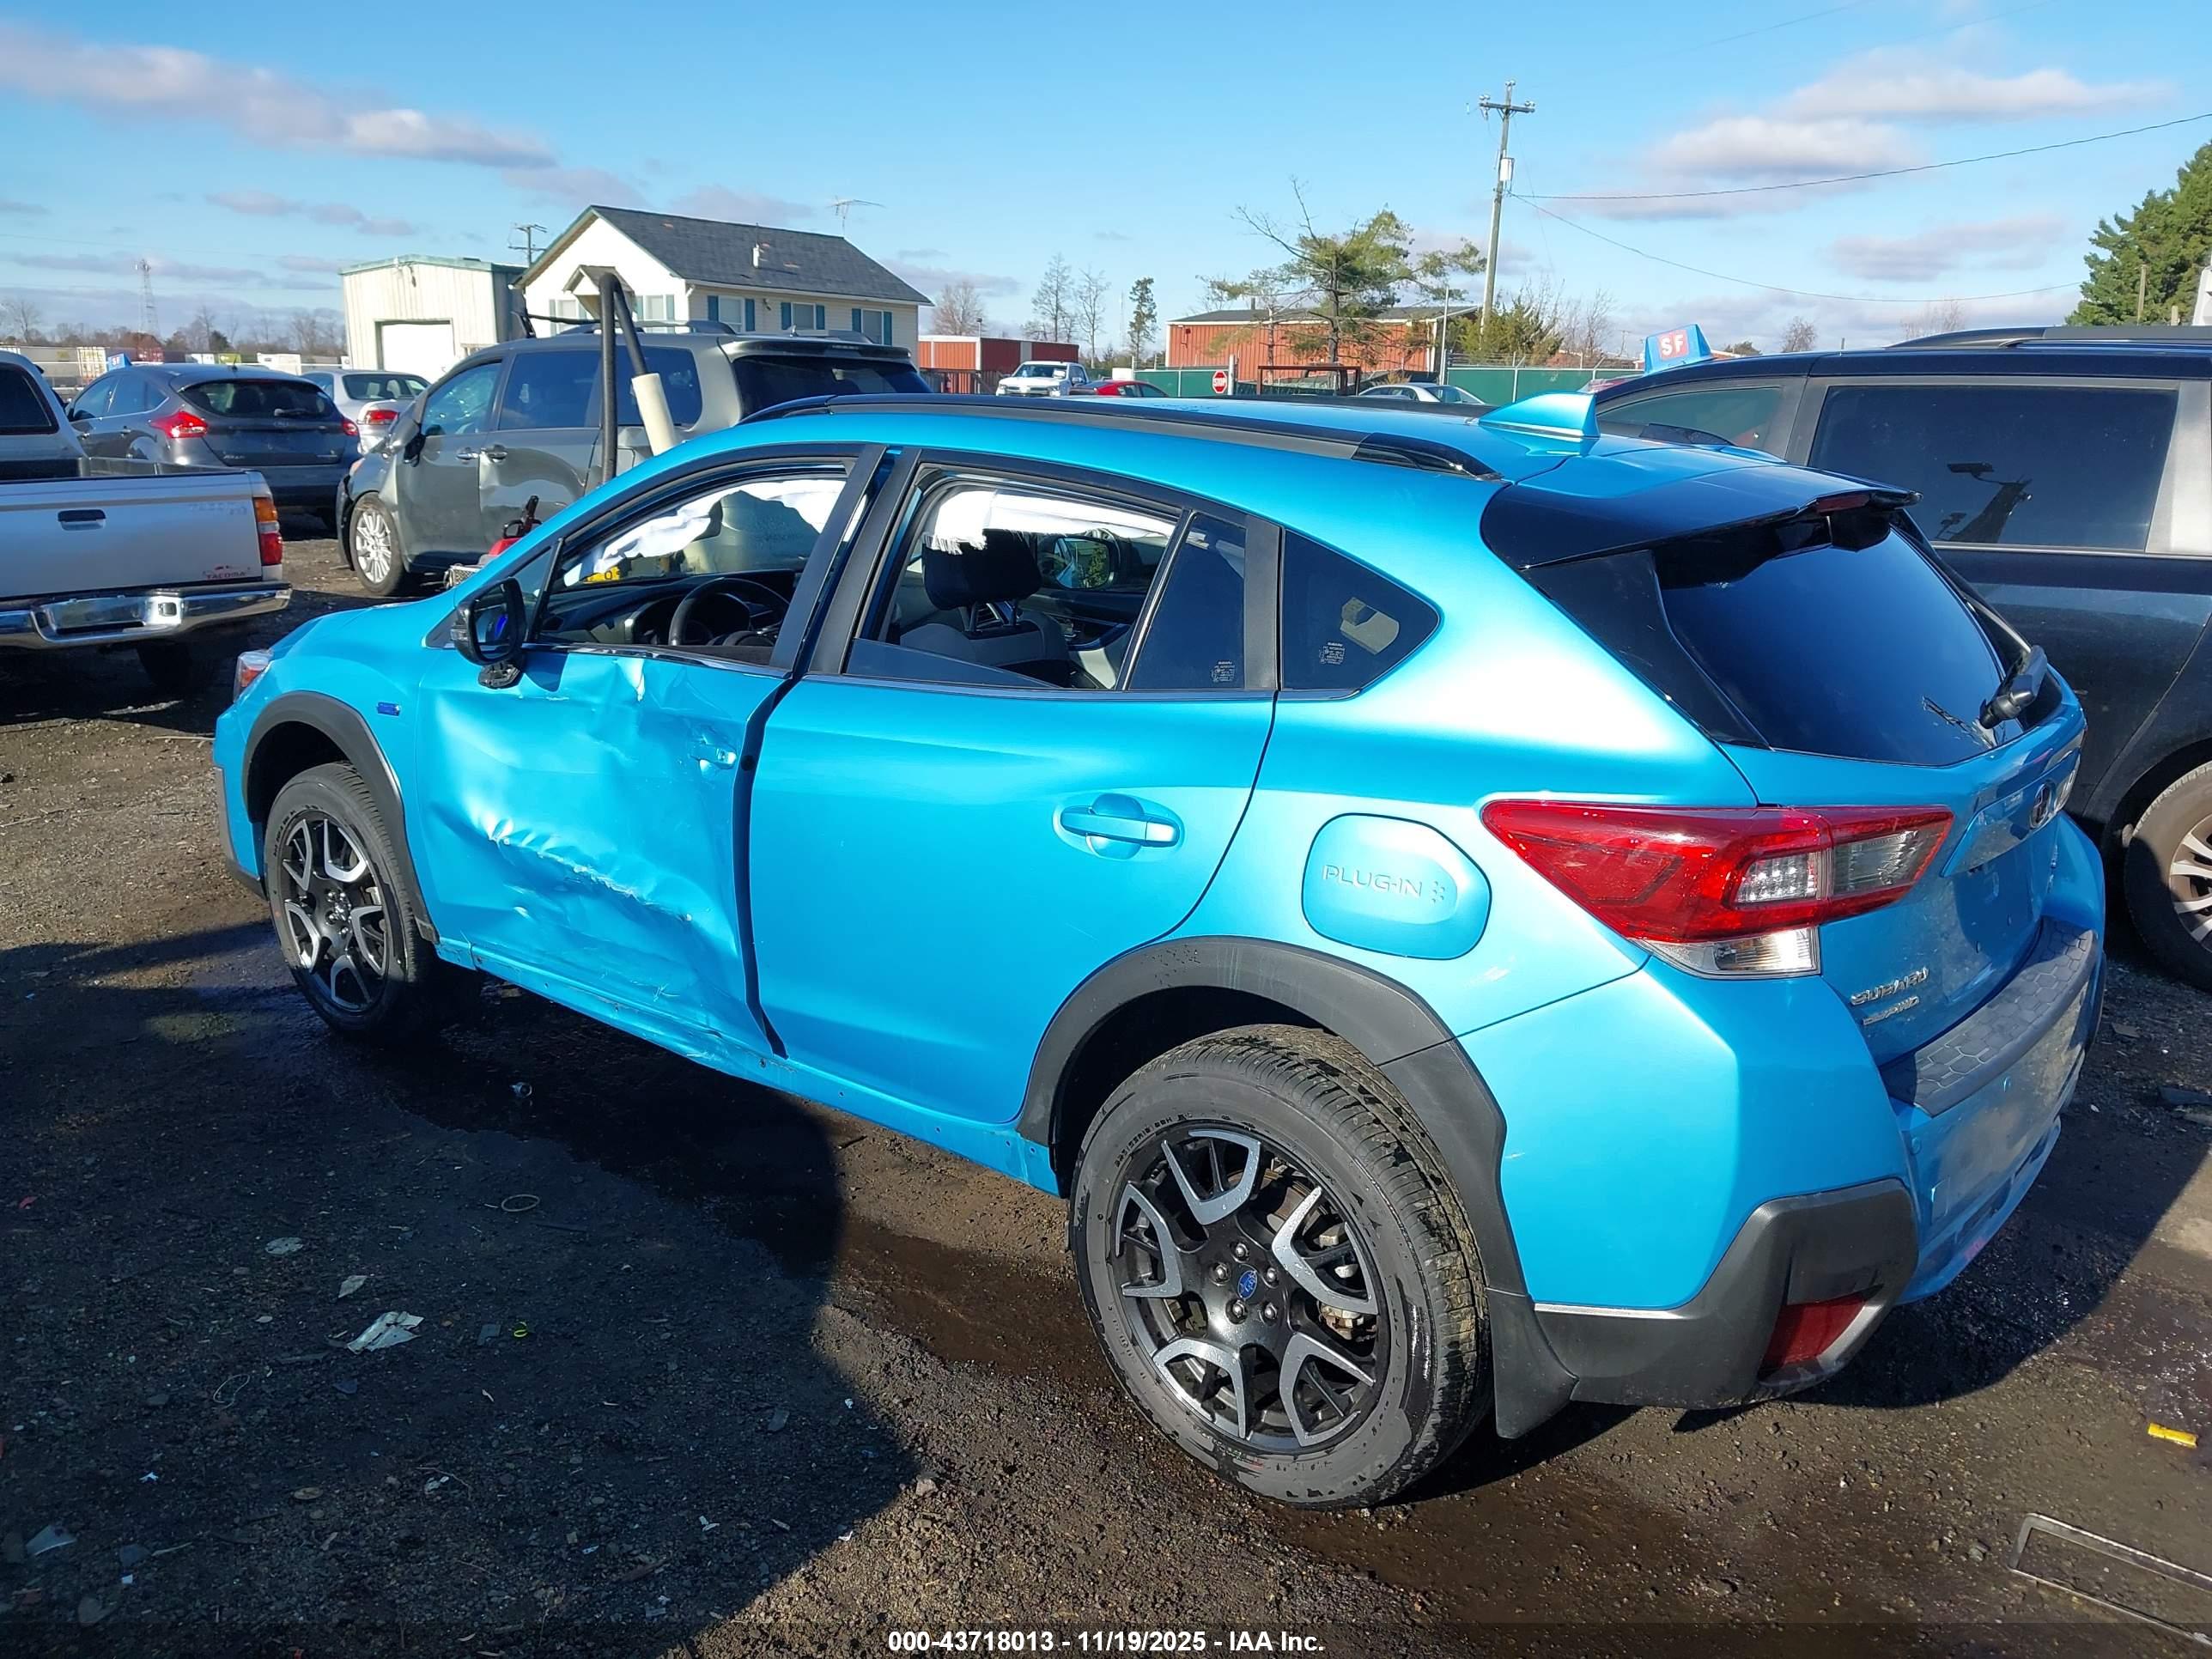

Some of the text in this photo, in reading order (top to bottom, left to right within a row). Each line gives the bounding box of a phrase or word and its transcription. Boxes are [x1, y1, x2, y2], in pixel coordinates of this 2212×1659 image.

[1661, 334, 1684, 356] SF
[1212, 378, 1227, 386] STOP
[206, 571, 247, 580] TACOMA
[1322, 864, 1423, 897] PLUG-IN
[1850, 966, 1929, 1006] SUBARU
